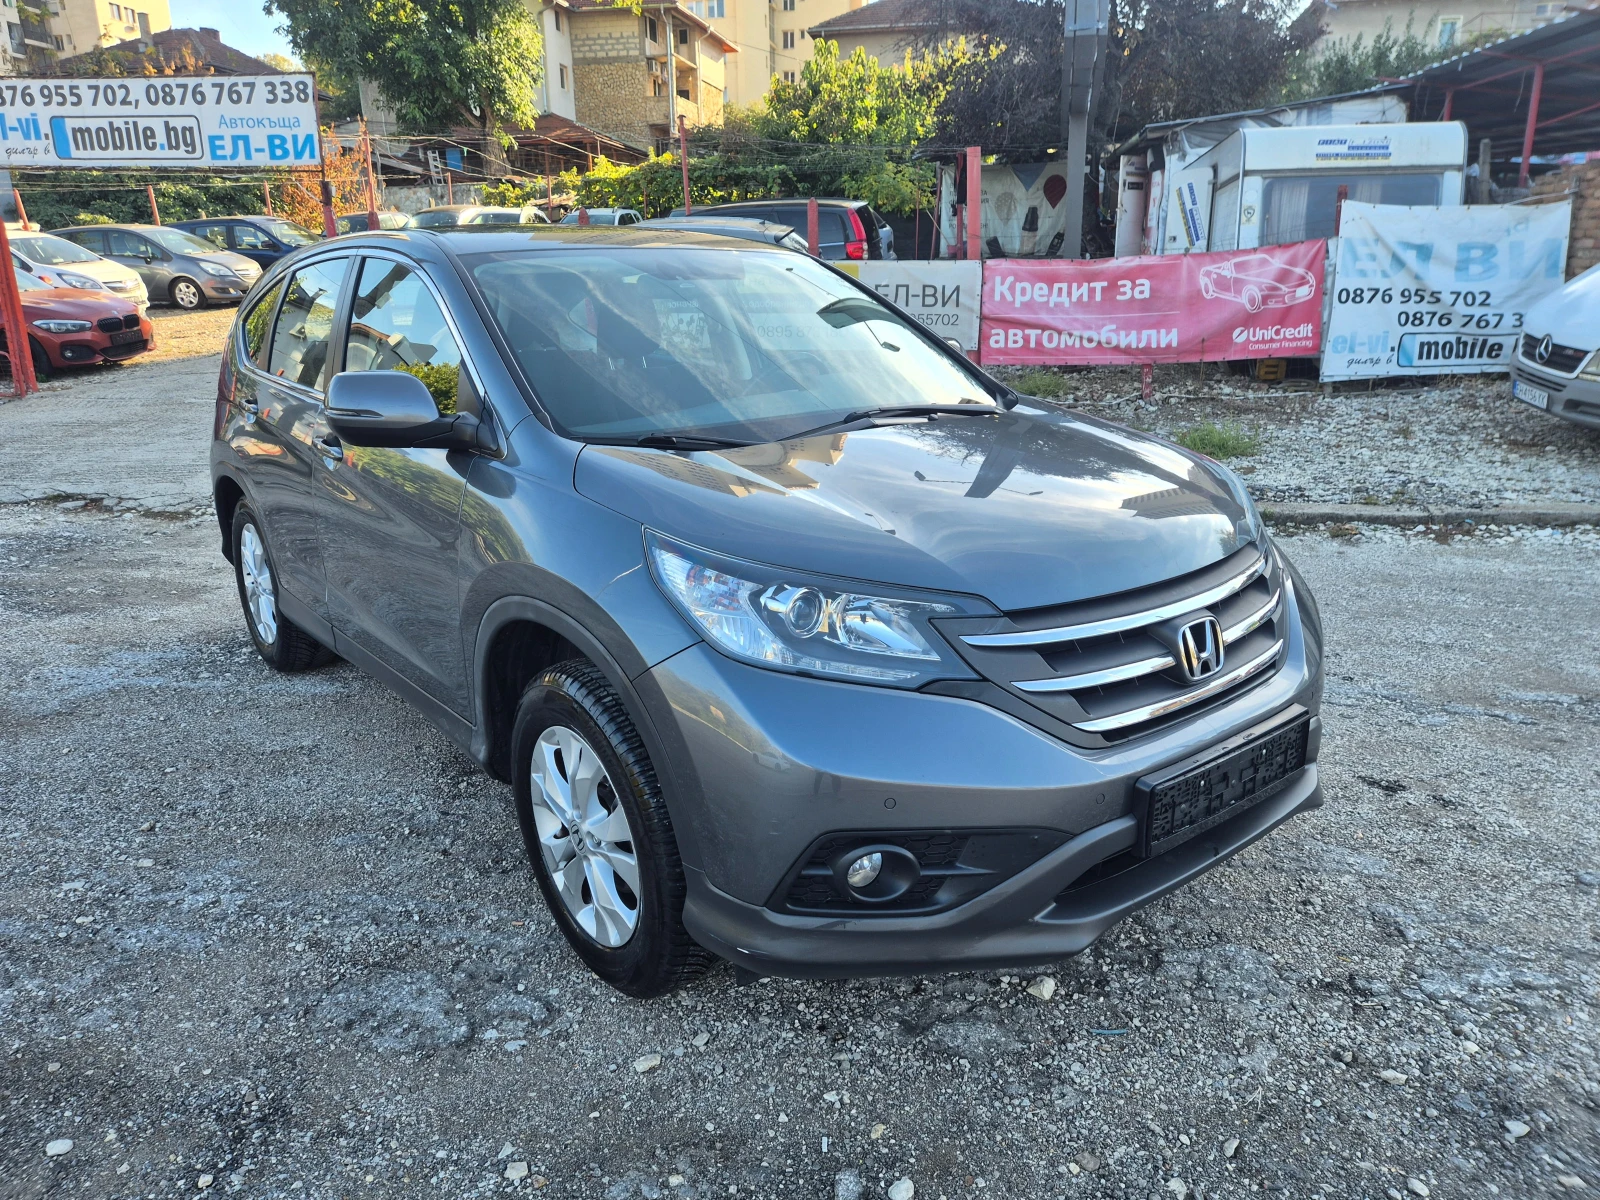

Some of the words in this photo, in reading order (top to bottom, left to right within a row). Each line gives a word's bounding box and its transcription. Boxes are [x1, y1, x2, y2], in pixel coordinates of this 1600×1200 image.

[39, 85, 83, 107] 955
[87, 84, 139, 109] 702,
[145, 80, 206, 106] 0876
[211, 81, 256, 105] 767
[264, 80, 310, 104] 338
[218, 114, 301, 129] Автокъща
[71, 120, 197, 155] mobile.bg
[207, 133, 316, 161] ЕЛ-ВИ
[874, 284, 961, 308] ЕЛ-ВИ
[994, 276, 1108, 307] Кредит
[1116, 278, 1151, 301] за
[1337, 287, 1393, 304] 0876
[1400, 288, 1443, 306] 955
[1449, 290, 1492, 308] 702
[910, 312, 960, 326] 55702
[1397, 311, 1453, 328] 0876
[1460, 313, 1505, 329] 767
[757, 325, 793, 338] 0895
[988, 325, 1179, 349] автомобили
[1249, 323, 1313, 341] UniCredit
[1249, 342, 1280, 351] Consumer
[1281, 339, 1313, 348] Financing
